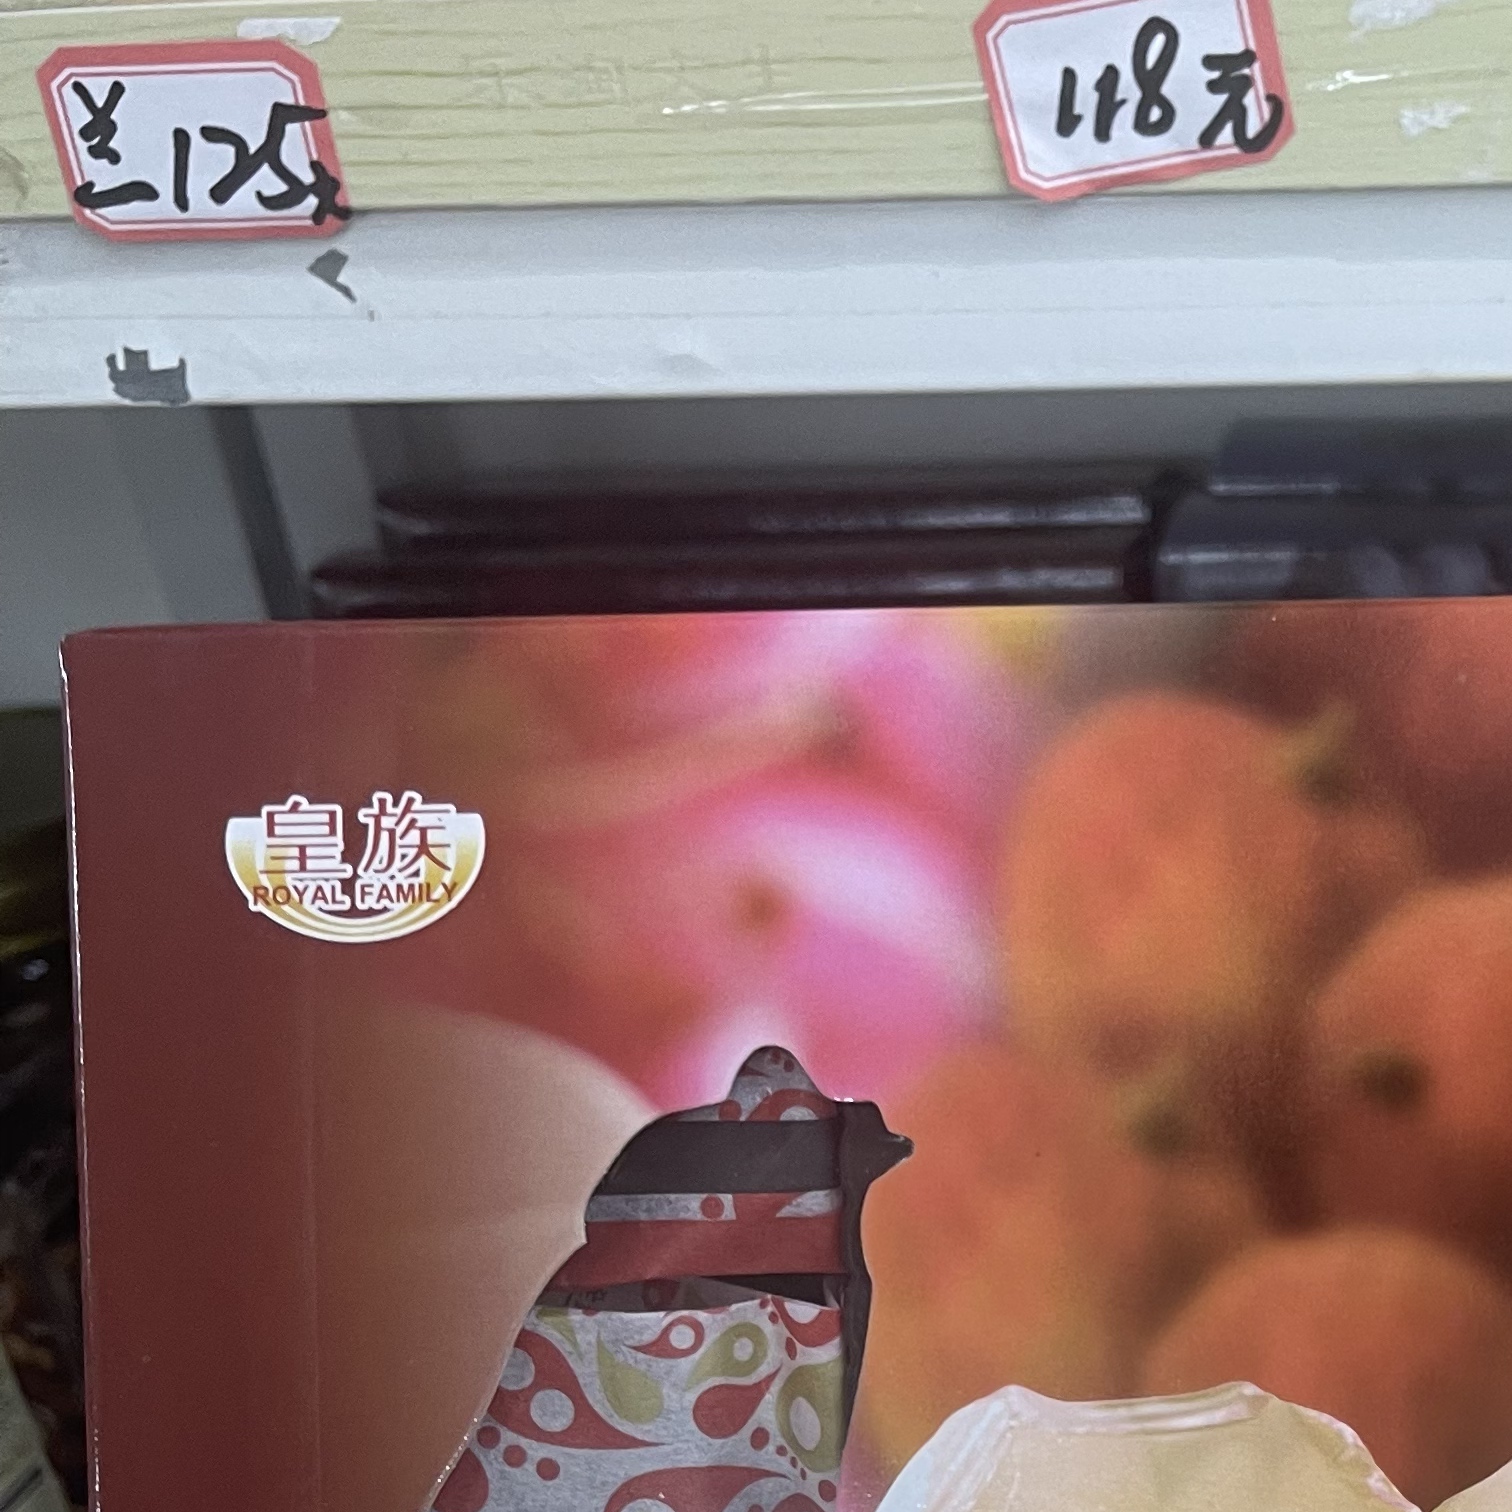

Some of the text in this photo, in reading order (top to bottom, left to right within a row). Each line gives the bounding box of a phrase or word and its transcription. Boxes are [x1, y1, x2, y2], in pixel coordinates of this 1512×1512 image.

[256, 792, 454, 876] 皇族
[252, 882, 458, 906] ROYAL FAMILY
